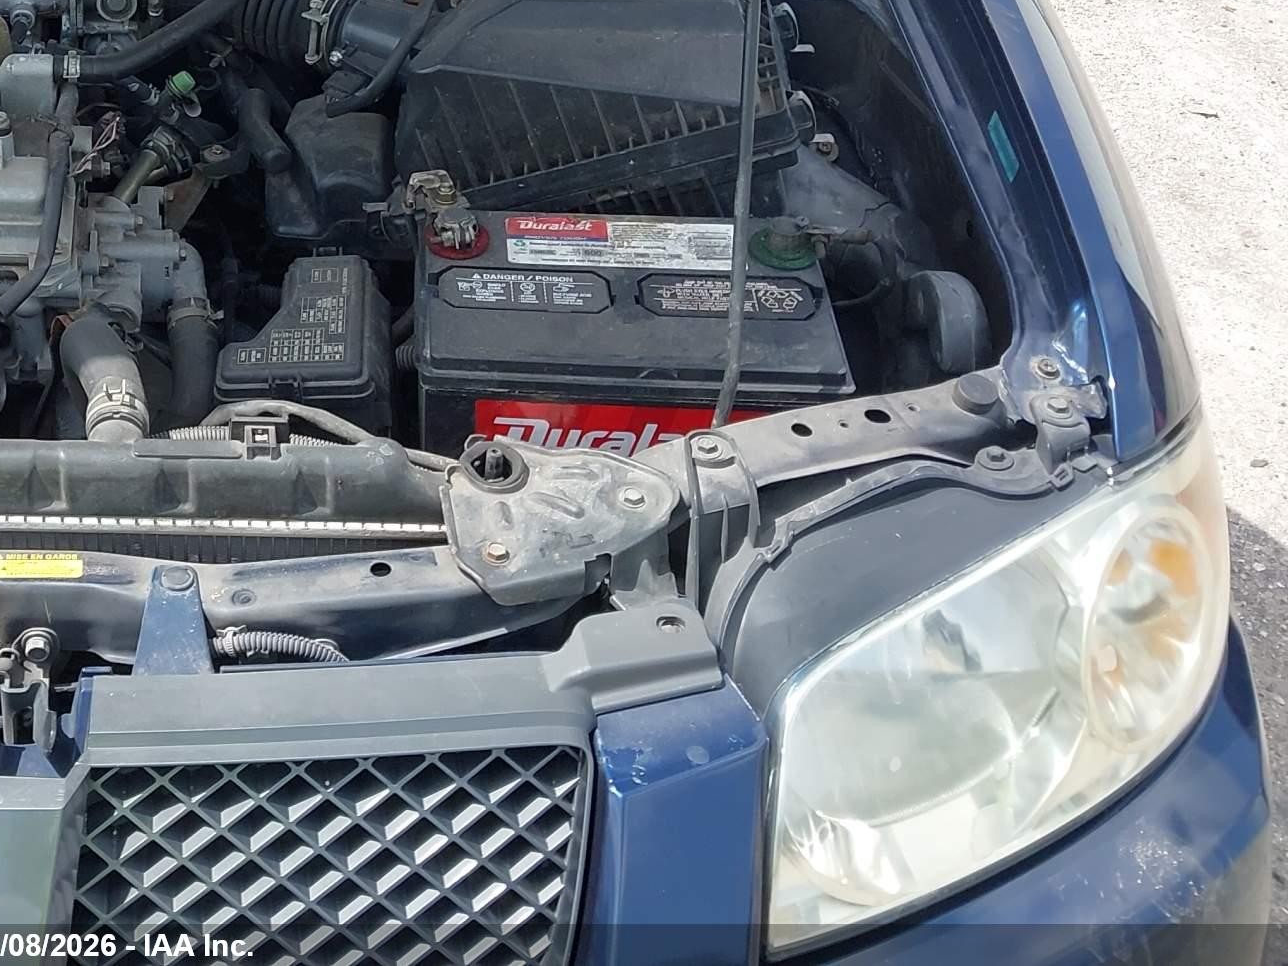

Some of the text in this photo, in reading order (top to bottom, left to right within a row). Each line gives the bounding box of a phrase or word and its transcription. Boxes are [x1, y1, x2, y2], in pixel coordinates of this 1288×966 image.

[516, 219, 593, 232] Duralast
[483, 273, 525, 282] DANGER
[535, 274, 574, 283] POISON
